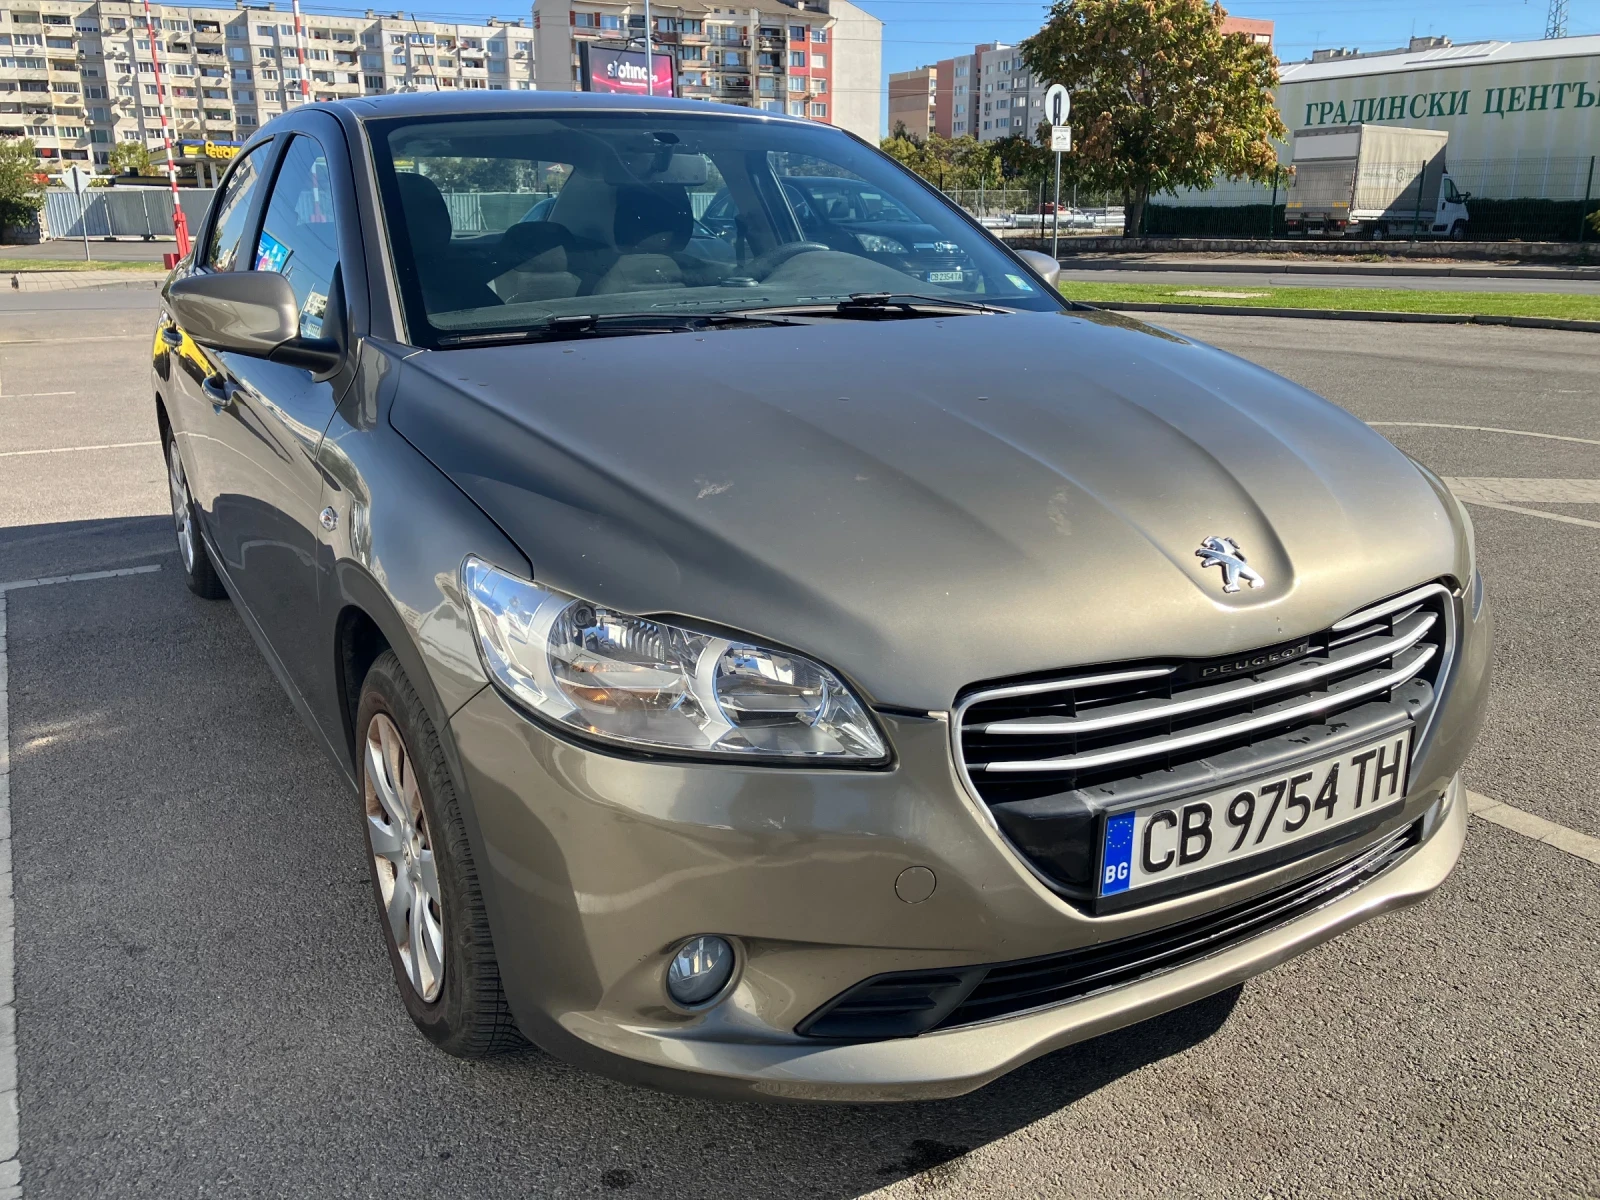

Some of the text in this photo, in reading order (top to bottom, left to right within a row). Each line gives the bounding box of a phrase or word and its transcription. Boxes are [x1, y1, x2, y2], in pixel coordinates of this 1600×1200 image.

[1304, 81, 1600, 126] ГРАДИНСКИ ЦЕНТЪ
[1202, 643, 1308, 677] PEUGEOT
[1142, 738, 1403, 873] CB 9754 TH
[1105, 861, 1128, 885] BG
